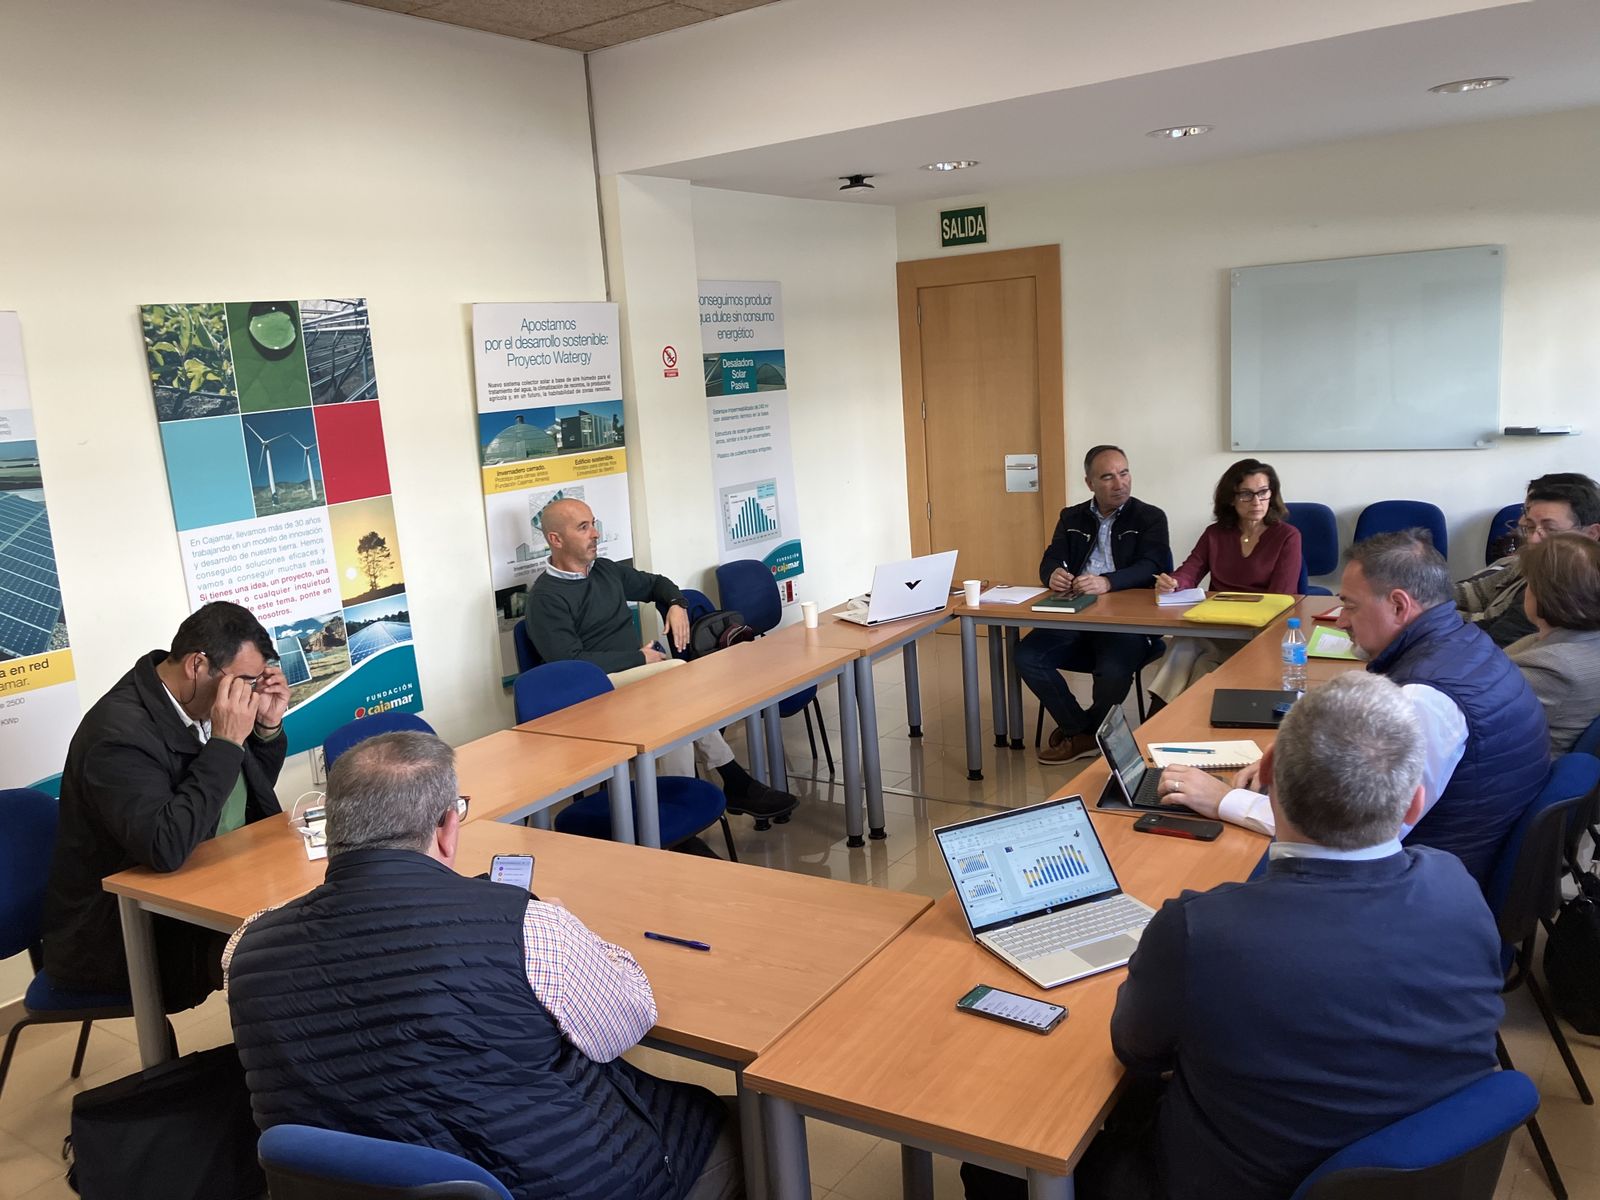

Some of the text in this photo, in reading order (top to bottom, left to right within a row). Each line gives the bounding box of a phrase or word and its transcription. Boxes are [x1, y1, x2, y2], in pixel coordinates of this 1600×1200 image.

[942, 214, 985, 240] SALIDA
[698, 293, 772, 308] onseguimos producir
[712, 310, 732, 322] dulce
[733, 310, 742, 322] sin
[743, 312, 774, 322] consumo
[520, 318, 576, 334] Apostamos
[718, 327, 754, 342] energético
[484, 333, 608, 354] por el desarrollo sostenible:
[507, 350, 592, 368] Proyecto Watergy
[722, 358, 754, 368] Desaladora
[732, 370, 746, 379] Solar
[730, 380, 749, 390] Pasiva
[202, 534, 235, 544] Cajamar,
[236, 528, 267, 538] llevamos
[268, 523, 283, 532] más
[305, 517, 321, 526] años
[192, 545, 230, 558] trabajando
[252, 536, 278, 546] modelo
[289, 527, 323, 538] innovación
[201, 555, 237, 567] desarrollo
[251, 547, 277, 557] nuestra
[279, 543, 298, 551] tierra.
[300, 538, 324, 547] Hemos
[196, 566, 241, 580] conseguido
[246, 556, 285, 569] soluciones
[289, 549, 318, 560] eficaces
[198, 580, 224, 590] vamos
[237, 569, 274, 582] conseguir
[278, 562, 306, 573] muchas
[210, 589, 233, 599] tienes
[282, 571, 314, 584] proyecto,
[254, 587, 290, 600] cualquier
[295, 577, 330, 590] inquietud
[258, 602, 274, 610] este
[300, 591, 320, 600] ponte
[258, 608, 292, 620] nosotros.
[10, 665, 25, 676] en
[29, 658, 49, 671] red
[366, 683, 412, 702] FUNDACIÓN
[6, 698, 25, 707] 2500
[368, 694, 414, 715] cajamar
